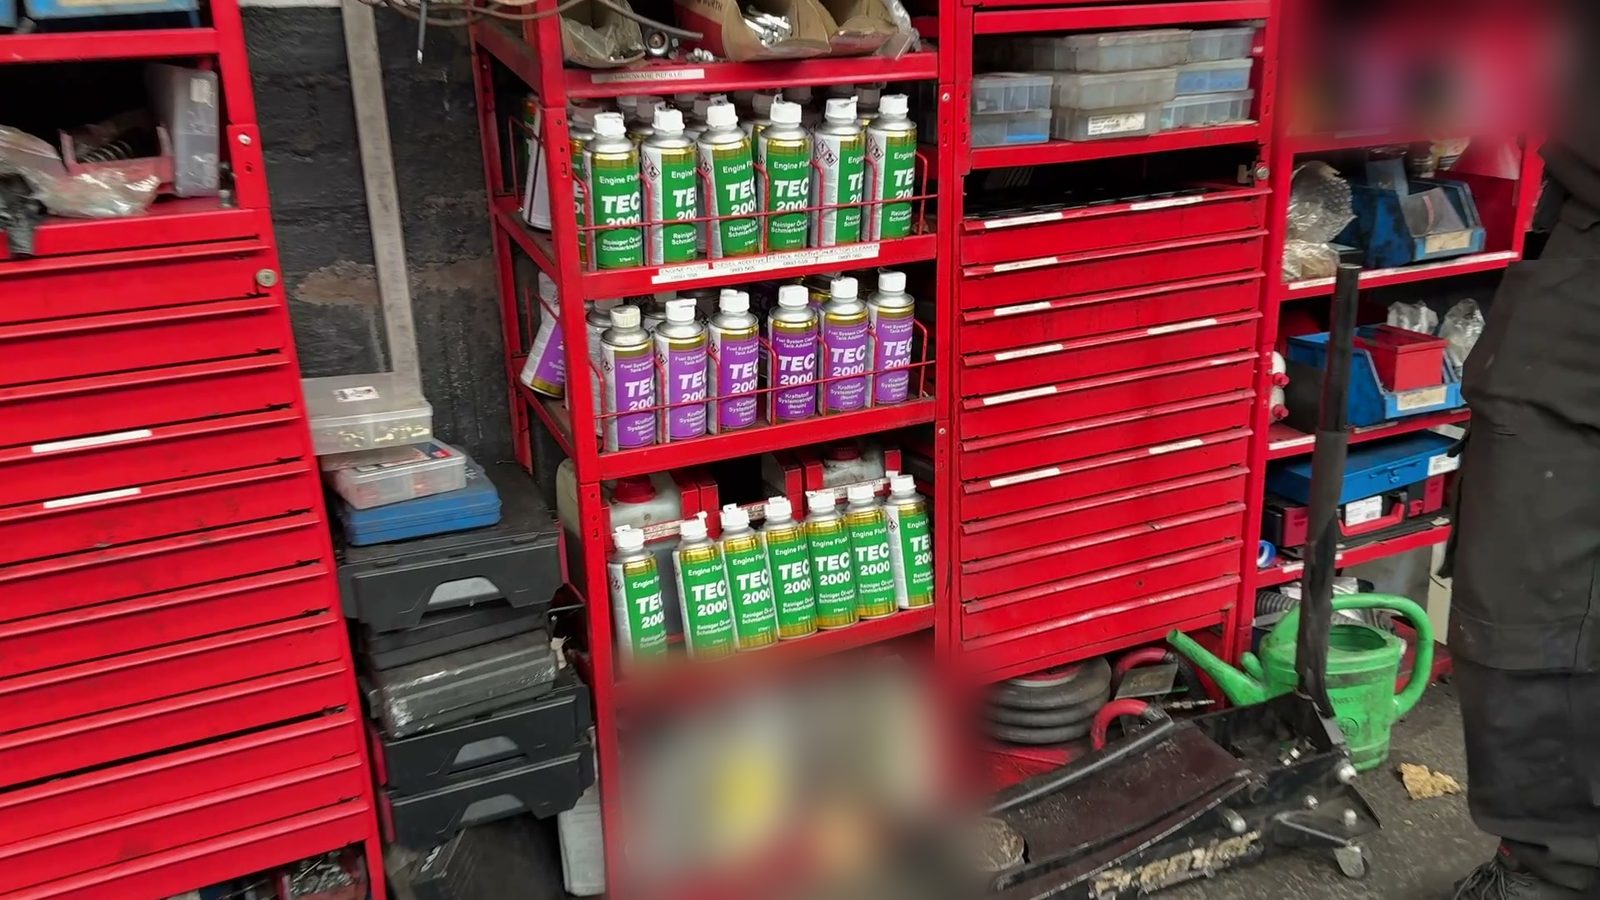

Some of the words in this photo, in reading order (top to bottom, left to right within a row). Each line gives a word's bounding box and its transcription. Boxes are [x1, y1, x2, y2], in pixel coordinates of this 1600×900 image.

[671, 169, 693, 180] Engine
[723, 163, 746, 174] Engine
[774, 161, 798, 171] Engine
[600, 175, 625, 186] Engine
[774, 177, 809, 198] TEC
[602, 191, 640, 213] TEC
[673, 187, 697, 208] TE
[778, 353, 815, 372] TEC
[831, 345, 866, 363] TEC
[780, 372, 813, 386] 2000
[832, 364, 864, 377] 2000
[852, 530, 874, 538] Engine
[775, 547, 797, 556] Engine
[812, 540, 833, 548] Engine
[910, 534, 931, 552] TE
[855, 542, 889, 562] TEC
[732, 557, 755, 566] Engine
[778, 559, 810, 580] TEC
[815, 551, 850, 572] TEC
[860, 560, 890, 576] 2000
[688, 567, 711, 577] Engine
[736, 568, 769, 591] TEC
[819, 570, 851, 586] 2000
[632, 579, 654, 589] Engine
[691, 580, 726, 602] TEC
[783, 577, 812, 595] 2000
[742, 587, 771, 605] 2000
[697, 599, 728, 617] 2000
